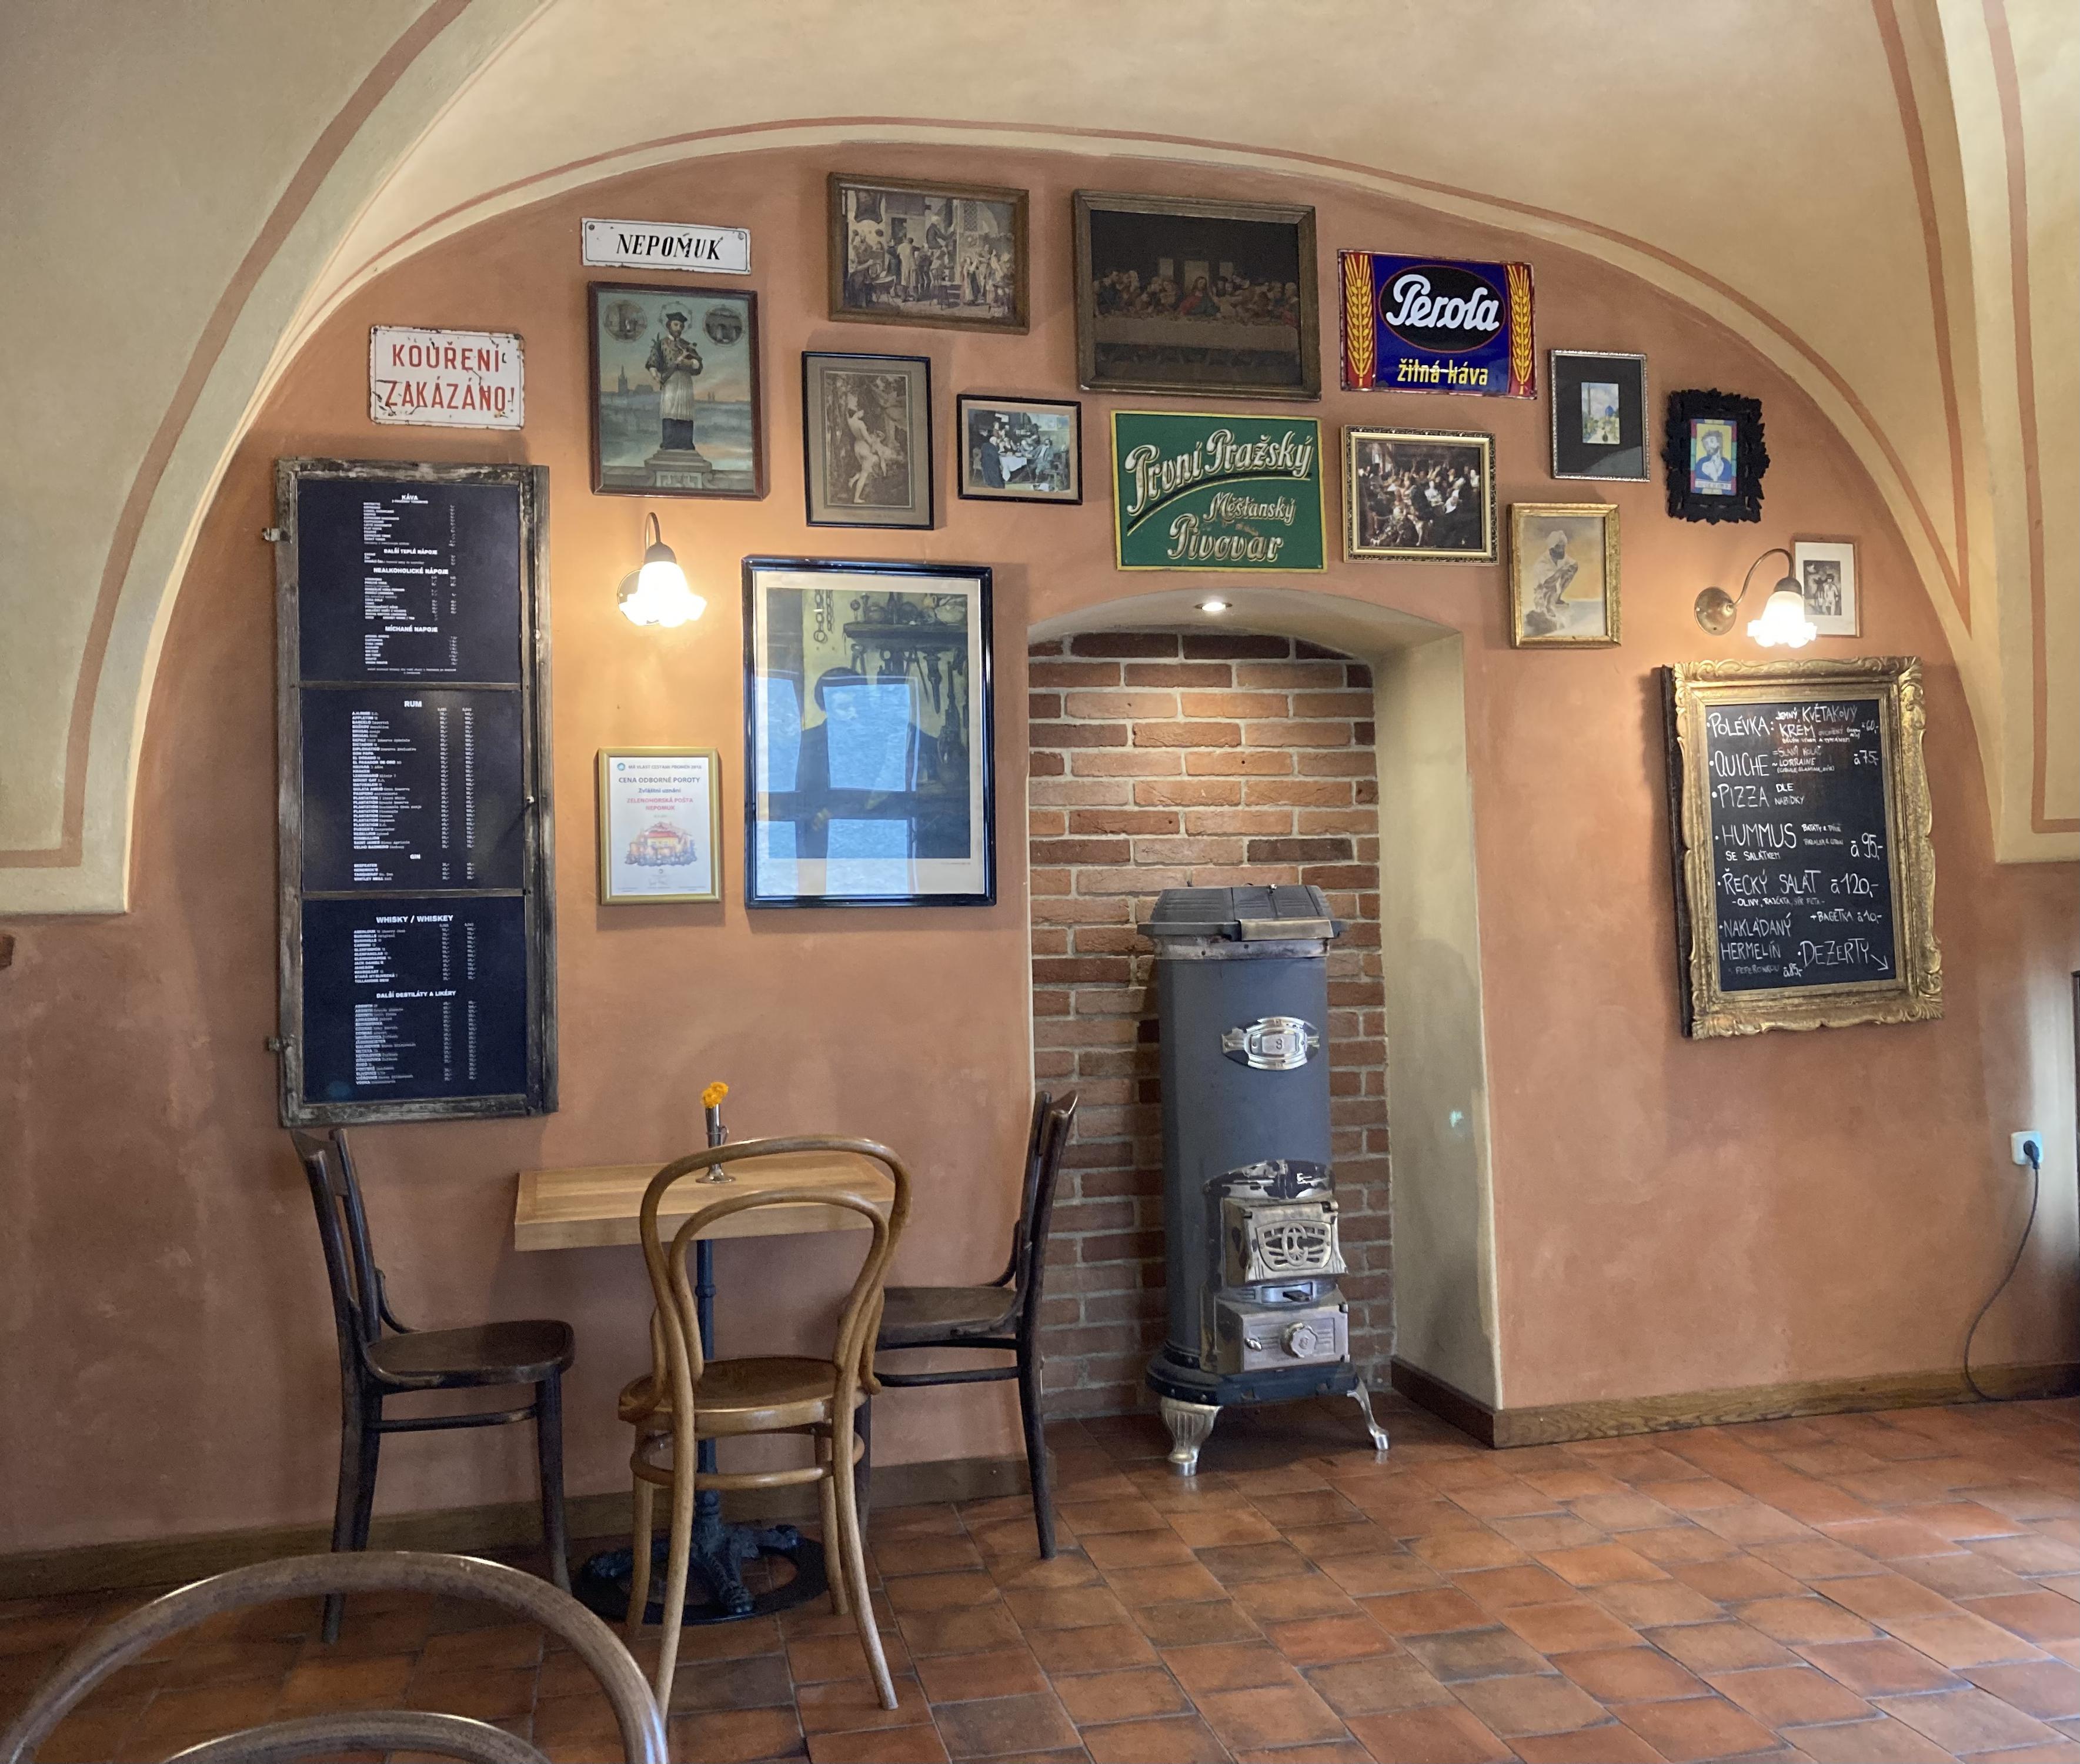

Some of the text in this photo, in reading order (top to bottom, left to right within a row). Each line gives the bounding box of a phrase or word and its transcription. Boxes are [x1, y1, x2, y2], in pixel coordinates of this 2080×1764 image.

[616, 233, 723, 260] NEPOMUK
[1386, 274, 1500, 331] Perola
[392, 341, 499, 372] KOUŘENÍ
[1397, 358, 1488, 386] žitná káva
[385, 376, 515, 412] ZAKÁZÁNO!
[1125, 429, 1314, 516] První Pražský
[1203, 492, 1296, 526] Měšťanský
[1167, 513, 1284, 562] Pivovar
[1714, 750, 1769, 777] QUICHE
[1779, 757, 1817, 767] LORRAINE
[1717, 783, 1794, 808] PIZZA DLE
[1722, 823, 1797, 848] HUMMUS
[1725, 851, 1738, 861] SE
[1722, 867, 1767, 896] ŘECKÝ
[1723, 913, 1791, 938] NAKLÁDANÝ
[1721, 941, 1781, 960] HERMELÍN
[1799, 938, 1869, 968] DEZERTY
